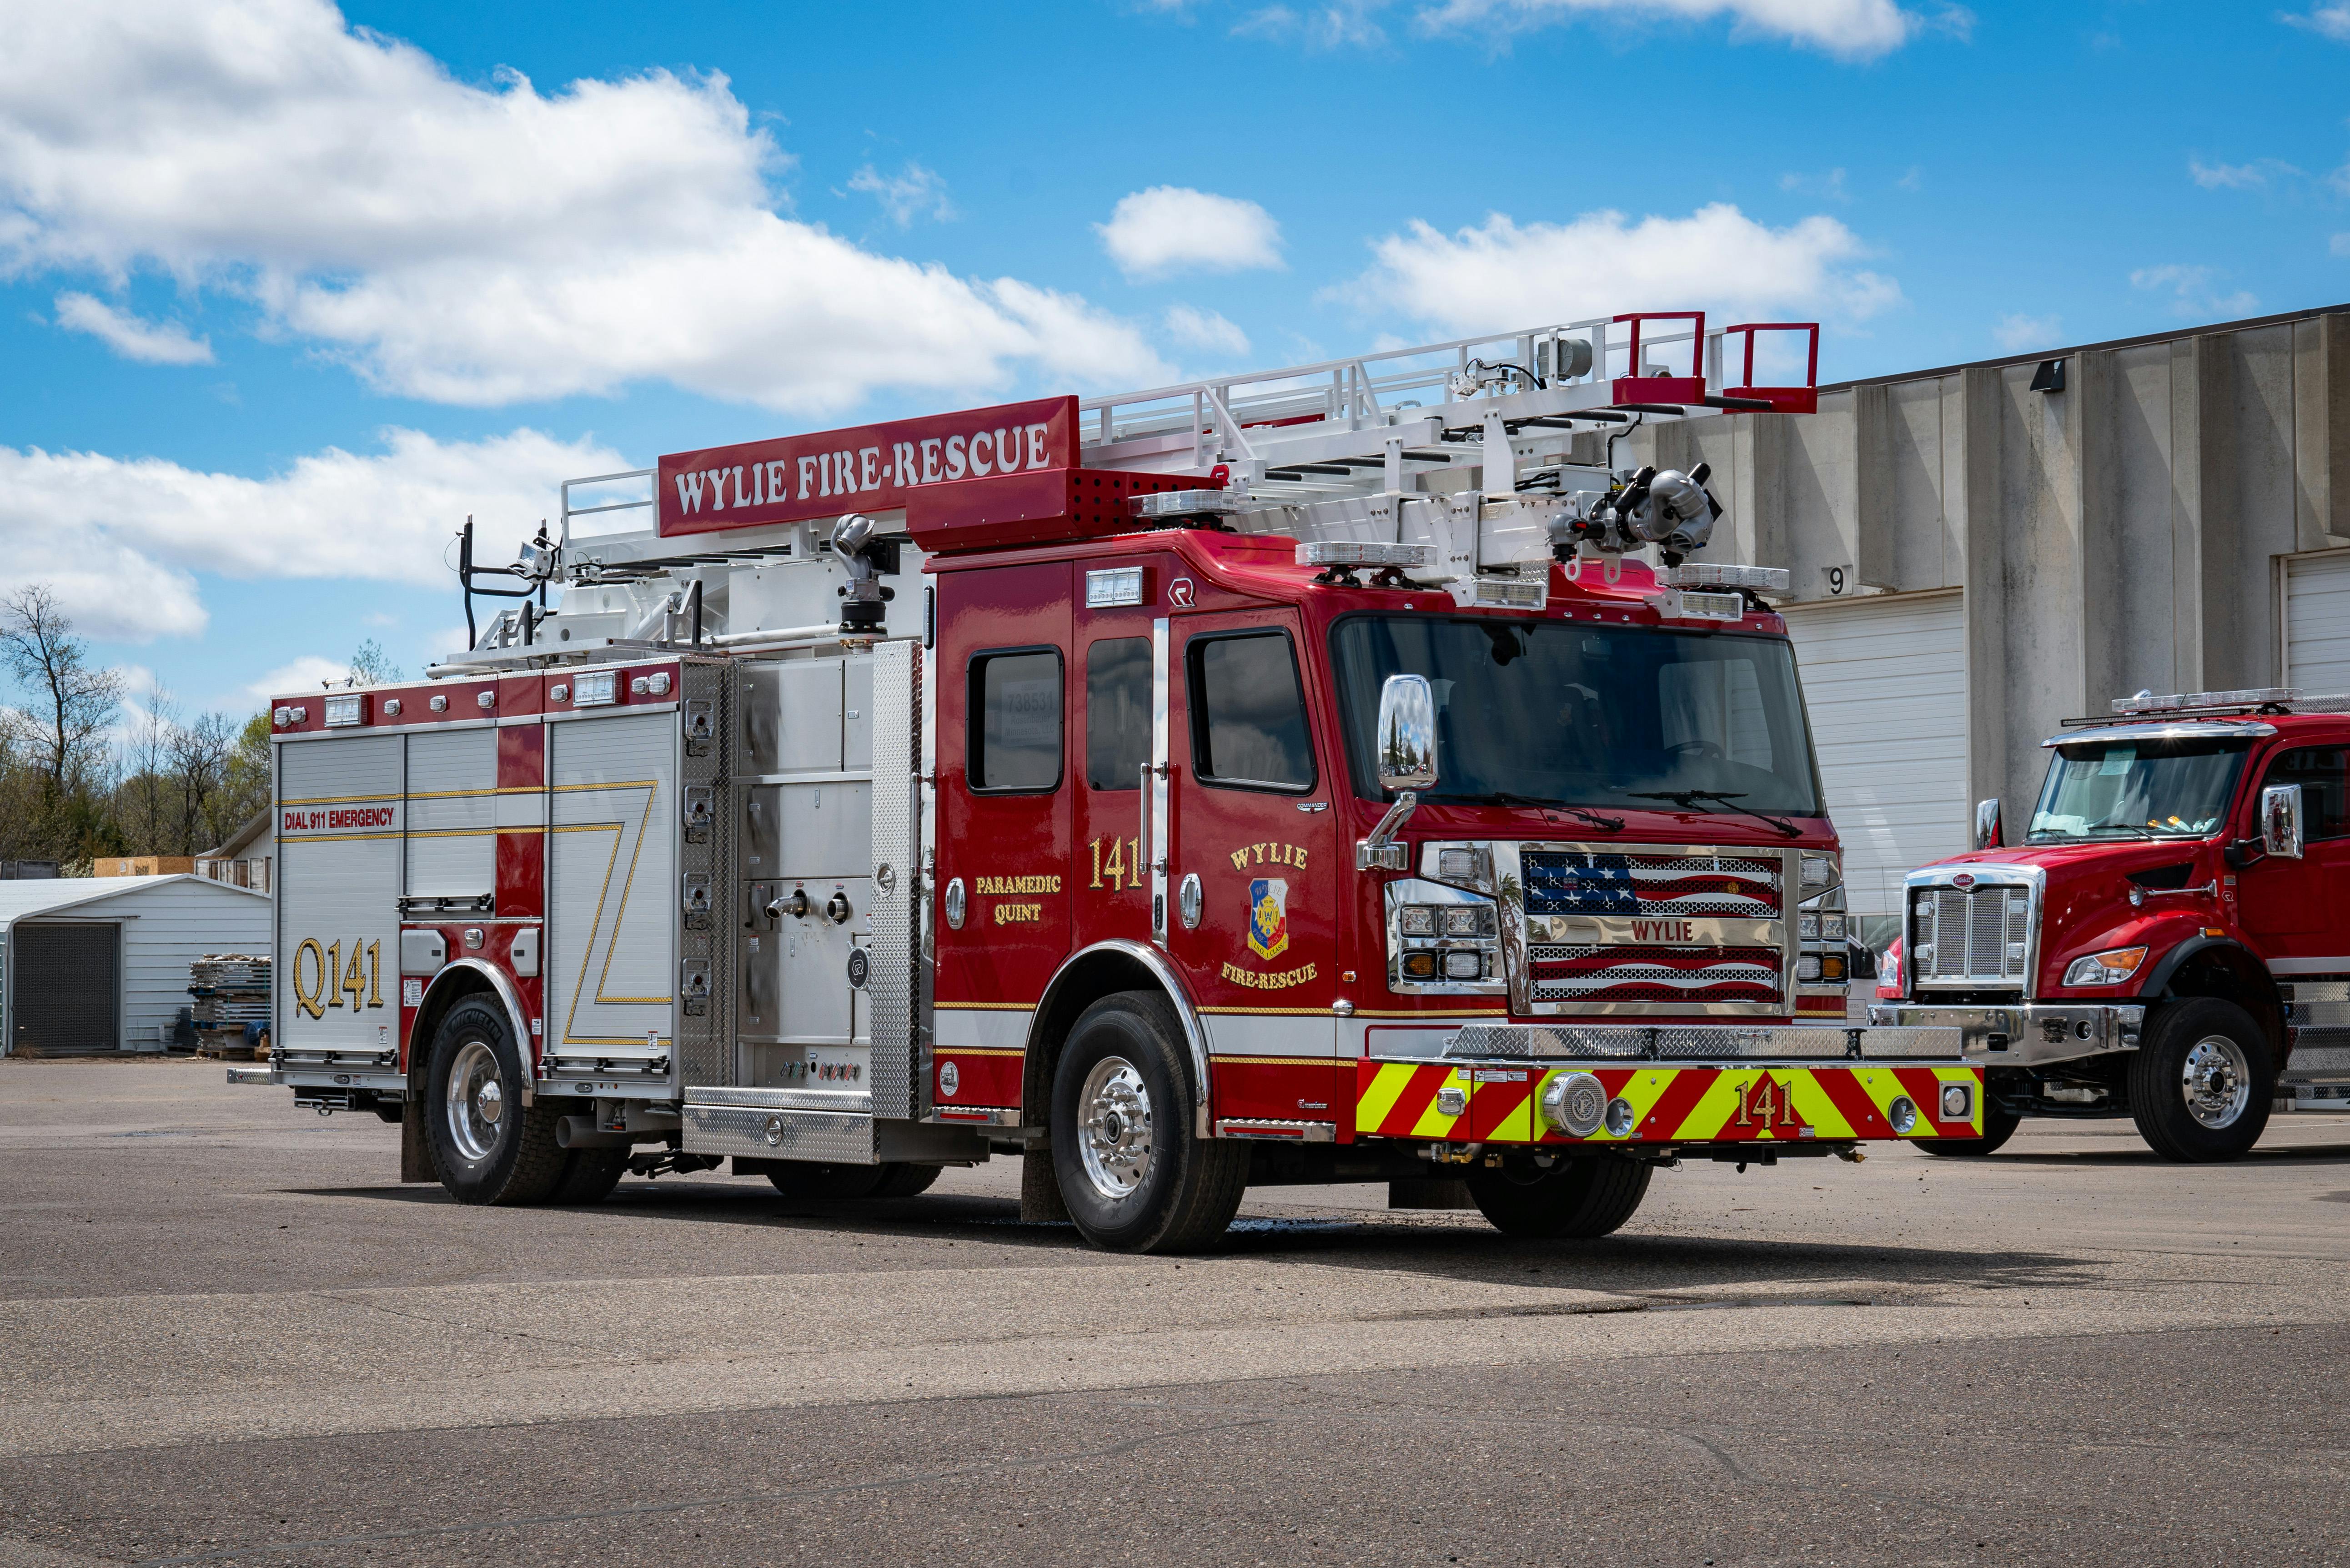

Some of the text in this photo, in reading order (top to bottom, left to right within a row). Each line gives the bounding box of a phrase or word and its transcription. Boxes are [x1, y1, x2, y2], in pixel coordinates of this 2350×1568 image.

[675, 422, 1050, 515] WYLIE FIRE-RESCUE
[1830, 567, 1843, 594] 9
[1007, 691, 1053, 713] 738531
[1005, 724, 1055, 737] Minnesota, LLC
[1011, 714, 1051, 725] Rosenbauer
[285, 808, 394, 830] DIAL 911 EMERGENCY
[1089, 835, 1143, 893] 141
[1230, 842, 1308, 872] WYLIE
[975, 875, 1061, 895] PARAMEDIC
[1255, 884, 1282, 896] WYLIE
[994, 903, 1041, 926] QUINT
[1631, 921, 1693, 941] WYLIE
[1253, 943, 1264, 956] I.S.O.
[1270, 943, 1283, 956] CLASS
[293, 938, 384, 1020] Q141
[1221, 961, 1317, 990] FIRE-RESCUE
[452, 1010, 502, 1040] MICHELIN
[1735, 1081, 1795, 1130] 141
[1132, 1095, 1160, 1211] MICHELIN
